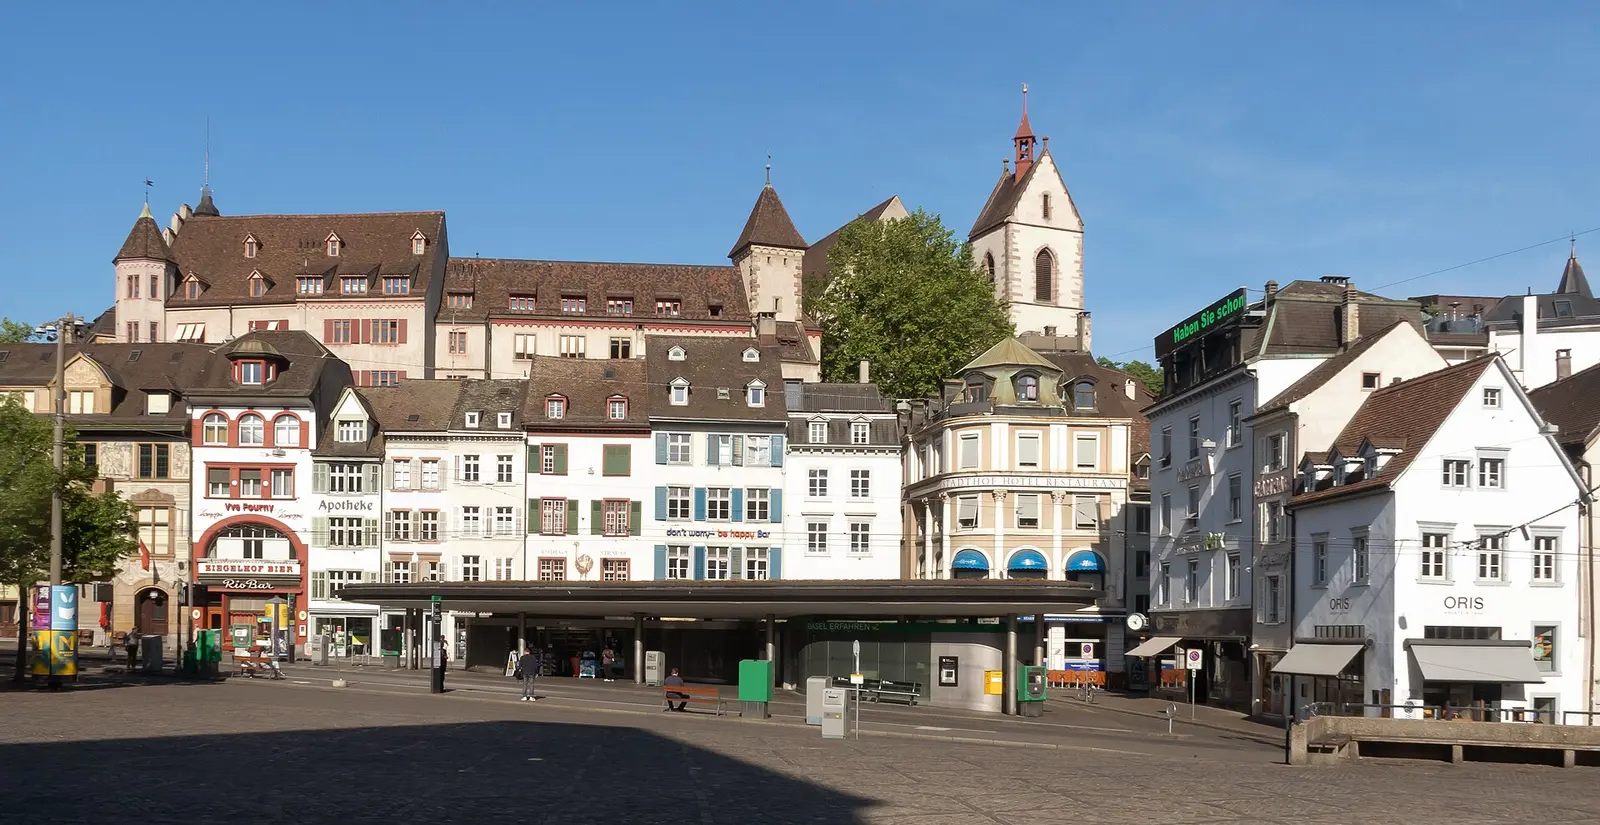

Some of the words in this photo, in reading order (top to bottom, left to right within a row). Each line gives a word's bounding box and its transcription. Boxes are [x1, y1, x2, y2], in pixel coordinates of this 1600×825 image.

[1173, 320, 1200, 344] Haben
[1201, 310, 1215, 329] Sie
[1216, 294, 1244, 320] schon
[941, 477, 997, 488] STADTHOF
[1003, 477, 1038, 486] HOTEL
[1046, 478, 1125, 488] RESTAURANT
[318, 499, 373, 513] Apotheke
[666, 528, 686, 538] don't
[717, 528, 728, 539] be
[730, 529, 755, 540] happy
[757, 529, 771, 539] Bar
[205, 564, 264, 573] ZIEGELHOF
[267, 565, 294, 574] BIER
[222, 579, 245, 590] Rio
[245, 579, 274, 590] Bar
[1329, 597, 1350, 610] ORIS
[1443, 596, 1484, 610] ORIS
[807, 622, 828, 630] BASEL
[829, 622, 871, 631] ERFAHREN
